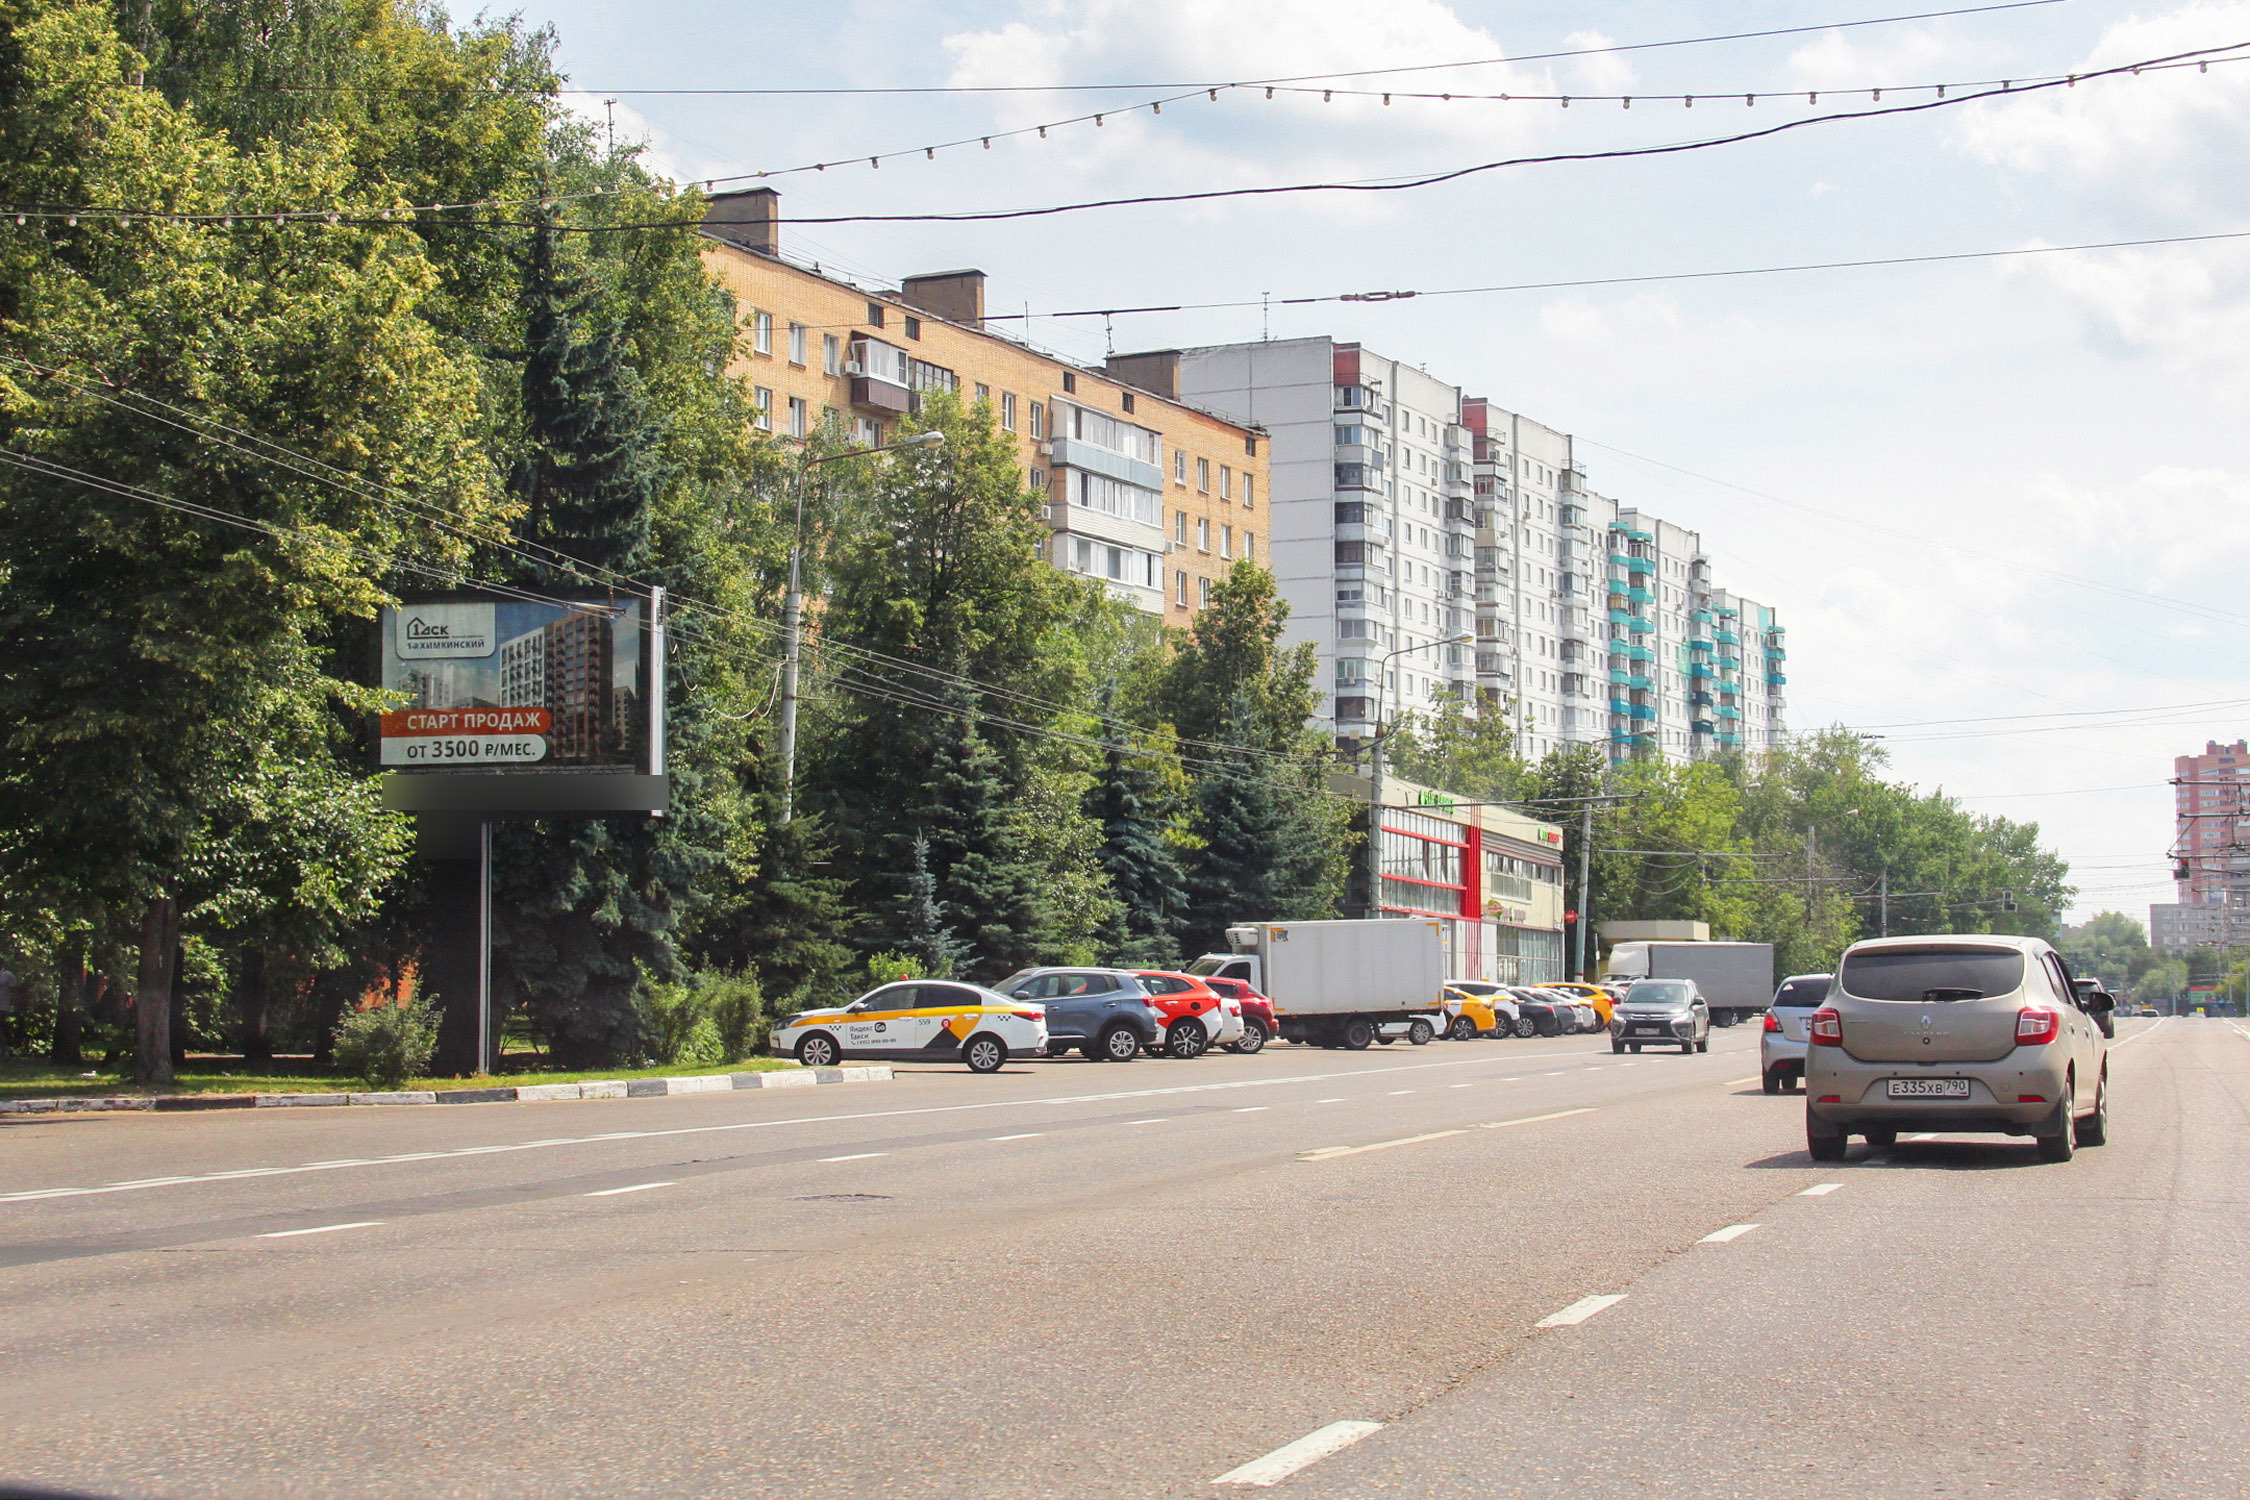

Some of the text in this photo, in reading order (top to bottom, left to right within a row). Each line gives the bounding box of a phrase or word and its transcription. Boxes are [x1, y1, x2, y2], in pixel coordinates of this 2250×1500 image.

[420, 639, 485, 650] ХИМКИНСКИЙ
[407, 712, 541, 731] СТАРТ ПРОДАЖ
[432, 740, 479, 758] 3500
[484, 742, 536, 756] ₽/МЕС.
[1946, 1080, 1966, 1090] 790
